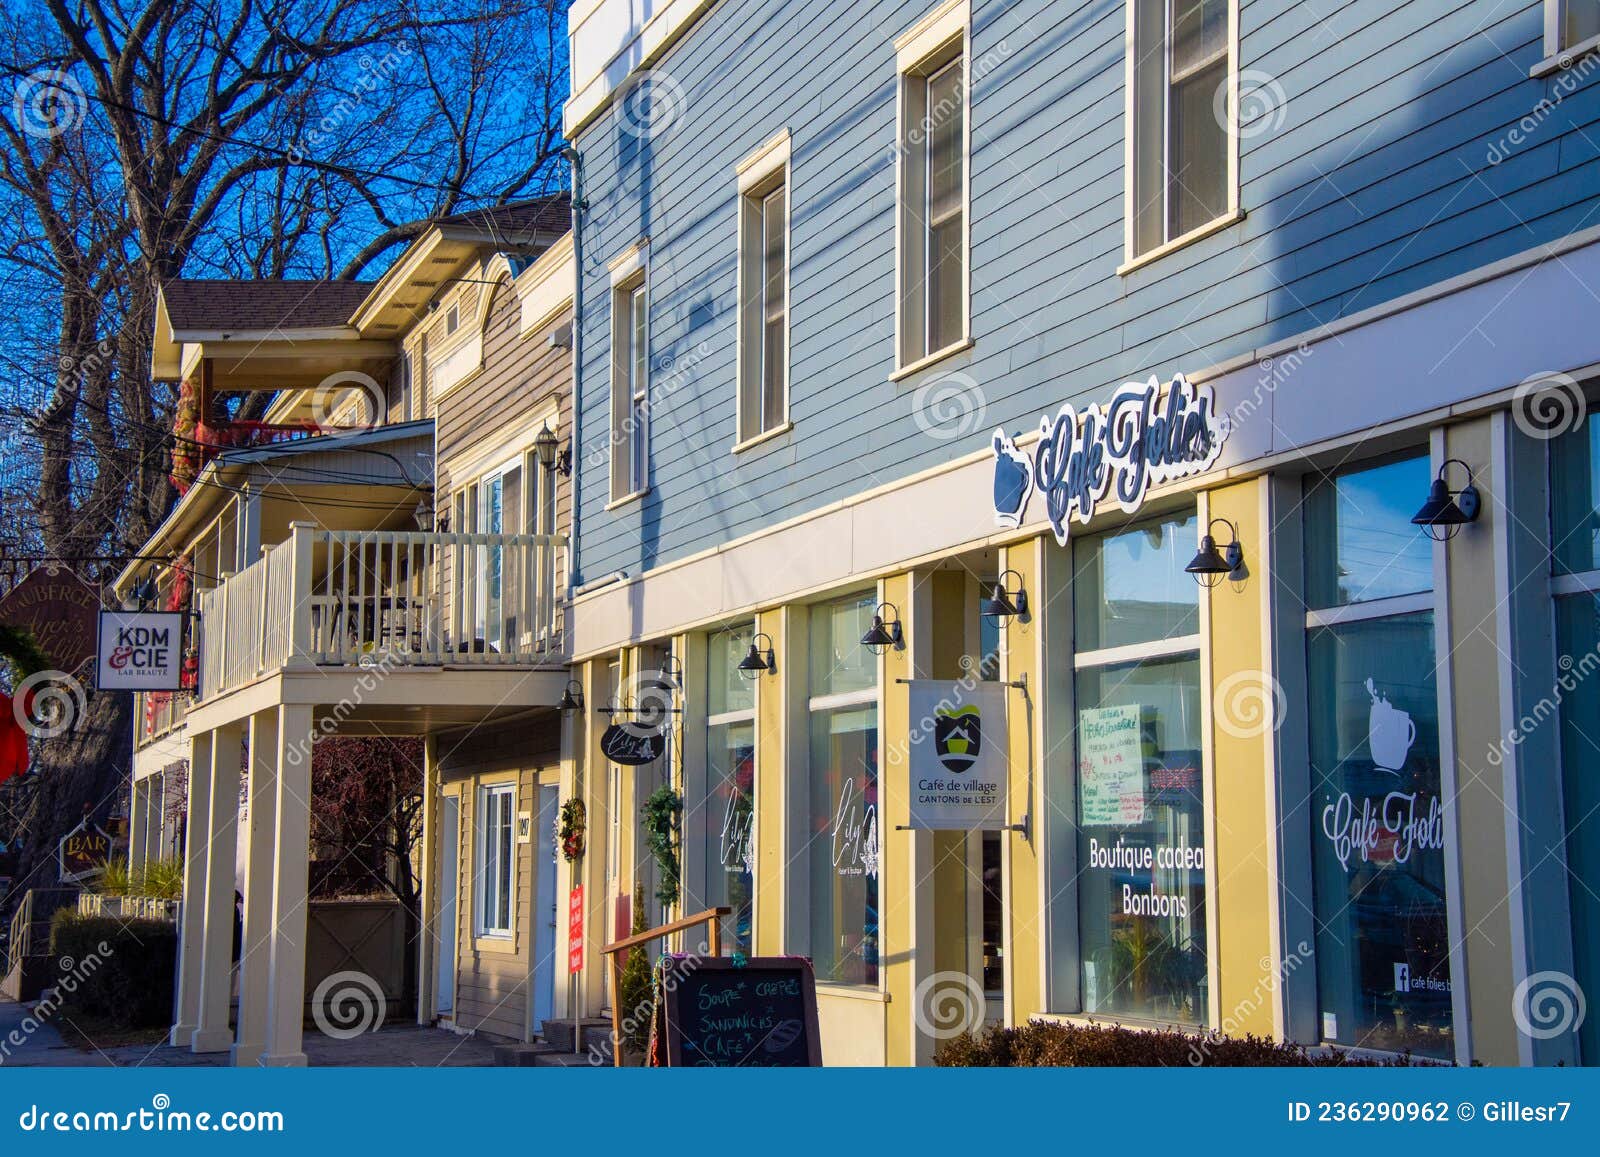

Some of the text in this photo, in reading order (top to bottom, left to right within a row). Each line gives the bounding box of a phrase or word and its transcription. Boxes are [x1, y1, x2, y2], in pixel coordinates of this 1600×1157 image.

[1107, 379, 1212, 503] Folies
[119, 627, 169, 647] KDM
[918, 779, 997, 795] Café de village
[919, 795, 960, 804] CANTONS
[974, 795, 997, 804] L'EST
[67, 836, 106, 855] BAR
[1322, 792, 1380, 873] Café
[1089, 838, 1153, 876] Boutique
[1122, 883, 1187, 917] Bonbons
